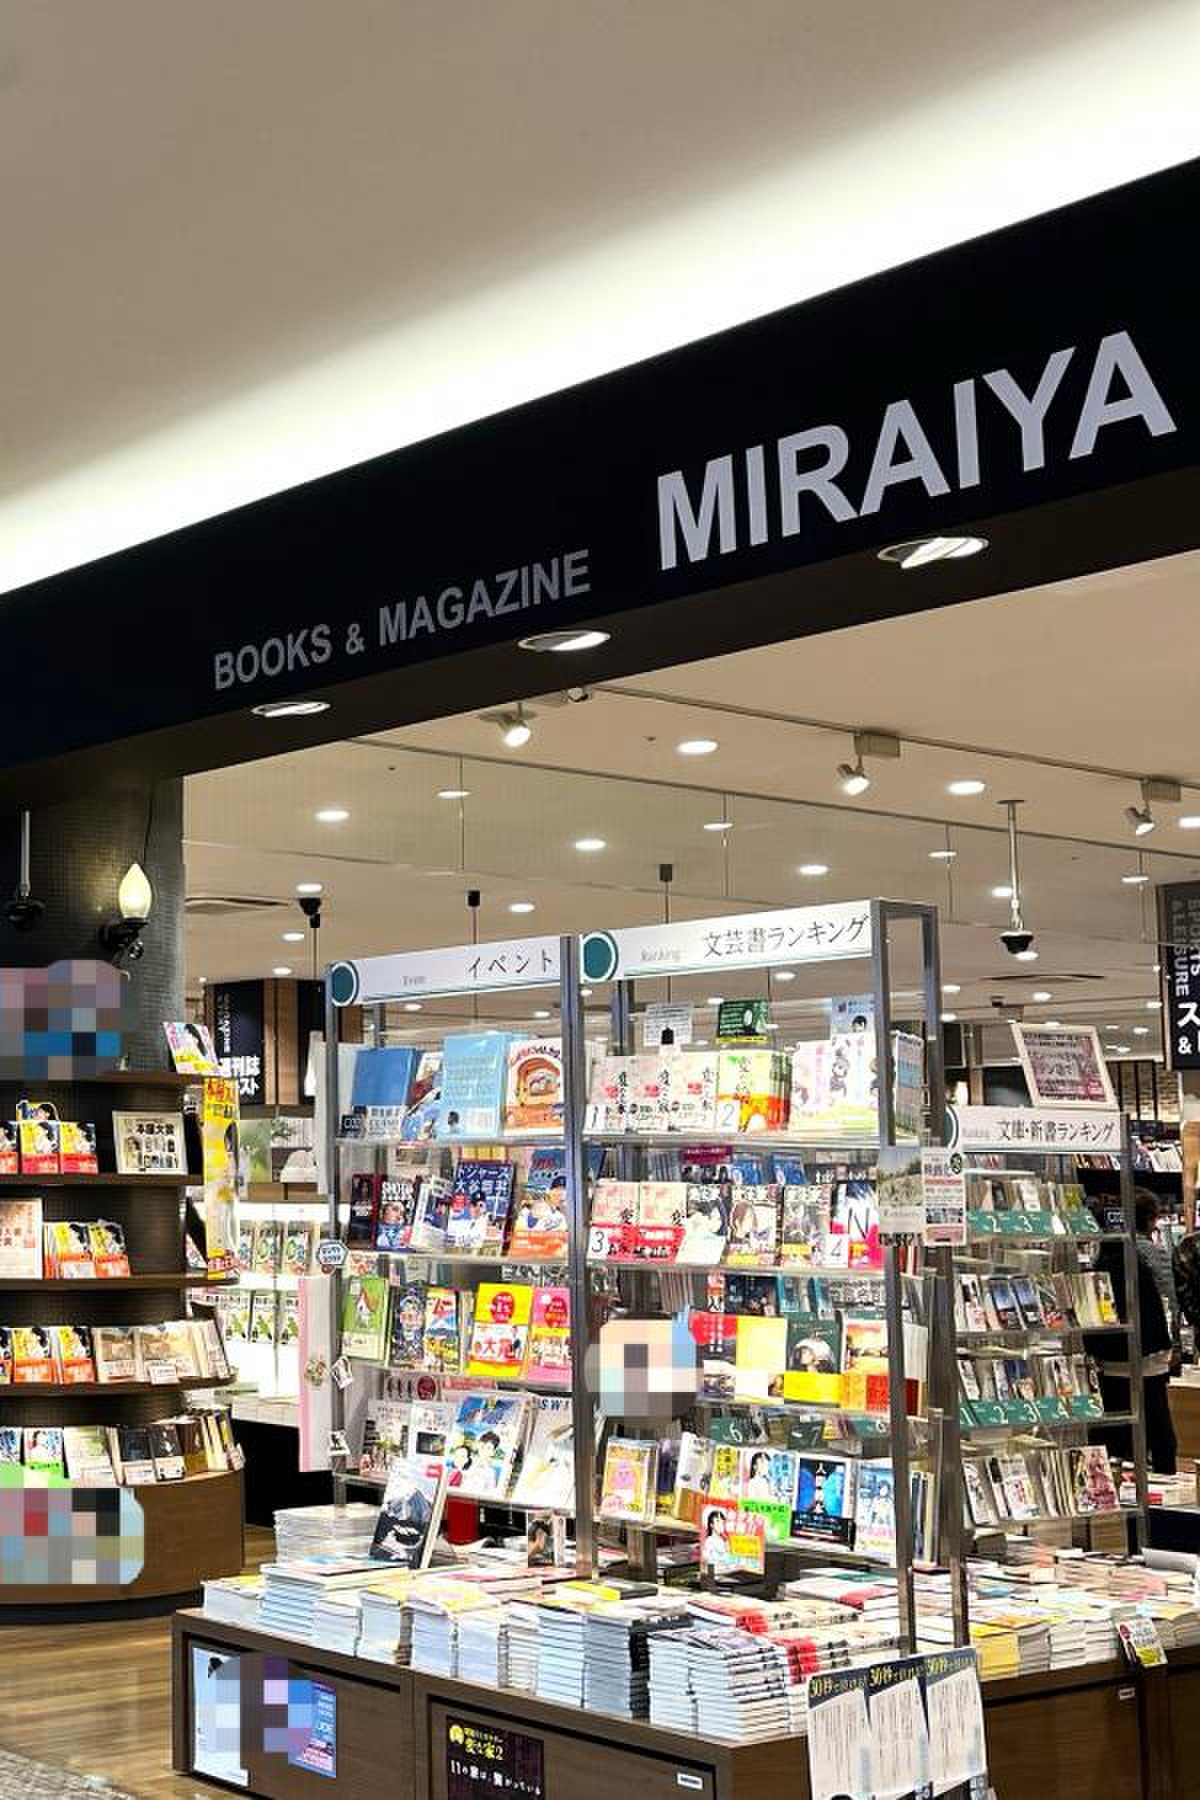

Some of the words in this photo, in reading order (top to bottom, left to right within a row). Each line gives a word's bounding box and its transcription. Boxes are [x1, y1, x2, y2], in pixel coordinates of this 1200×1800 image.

[656, 331, 1177, 571] MIRAIYA
[214, 623, 332, 691] BOOKS
[345, 623, 365, 656] &
[378, 549, 591, 647] MAGAZINE
[703, 913, 870, 959] 文芸書ランキング
[468, 949, 552, 980] イベント
[592, 1231, 605, 1253] 3
